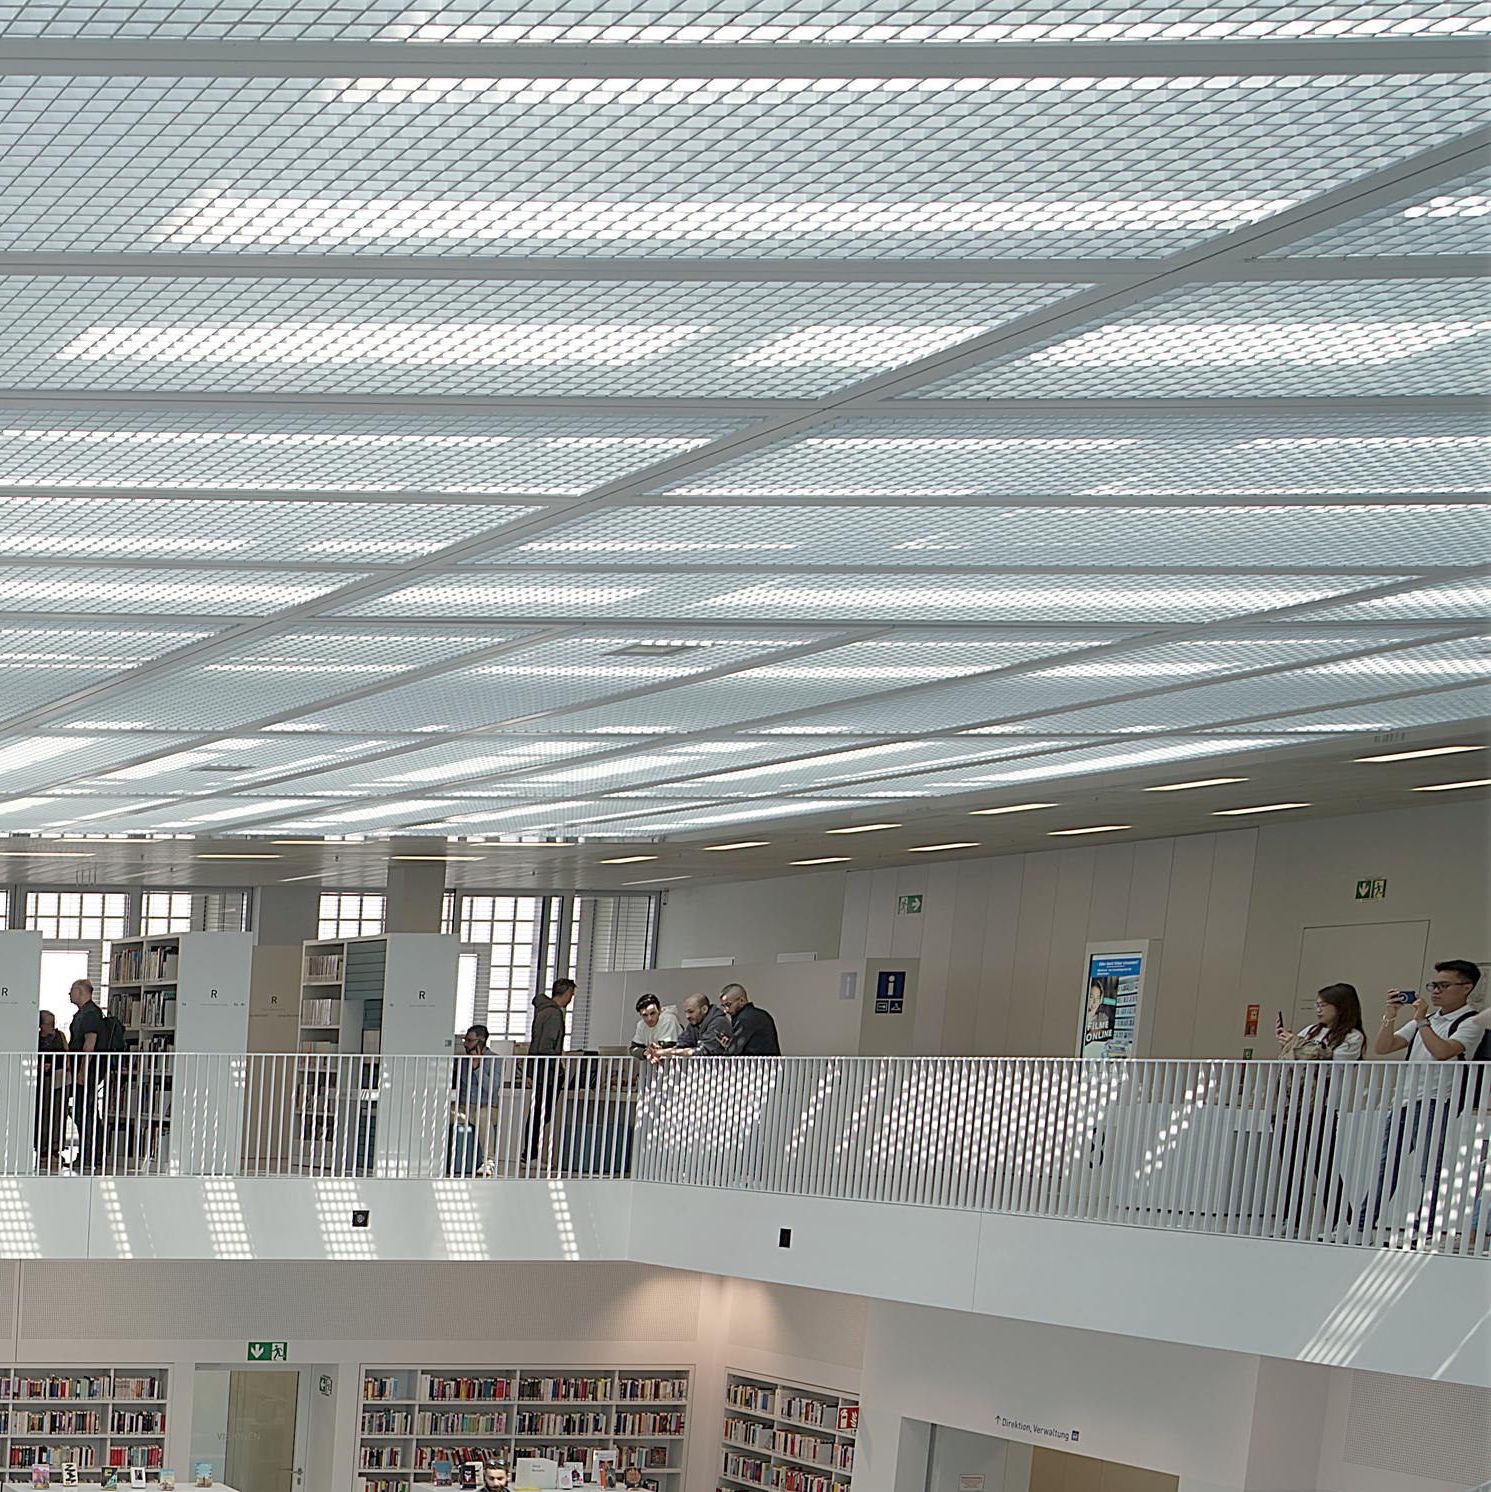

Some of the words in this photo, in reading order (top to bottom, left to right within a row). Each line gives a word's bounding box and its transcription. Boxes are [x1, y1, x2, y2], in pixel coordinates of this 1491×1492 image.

[1, 987, 9, 997] R
[210, 989, 218, 999] R
[418, 990, 426, 1000] R
[271, 995, 278, 1005] R
[1087, 1021, 1109, 1030] FILME
[1085, 1029, 1113, 1042] ONLINE
[1001, 1417, 1032, 1433] Direktion,
[1033, 1424, 1070, 1442] Verwaltung
